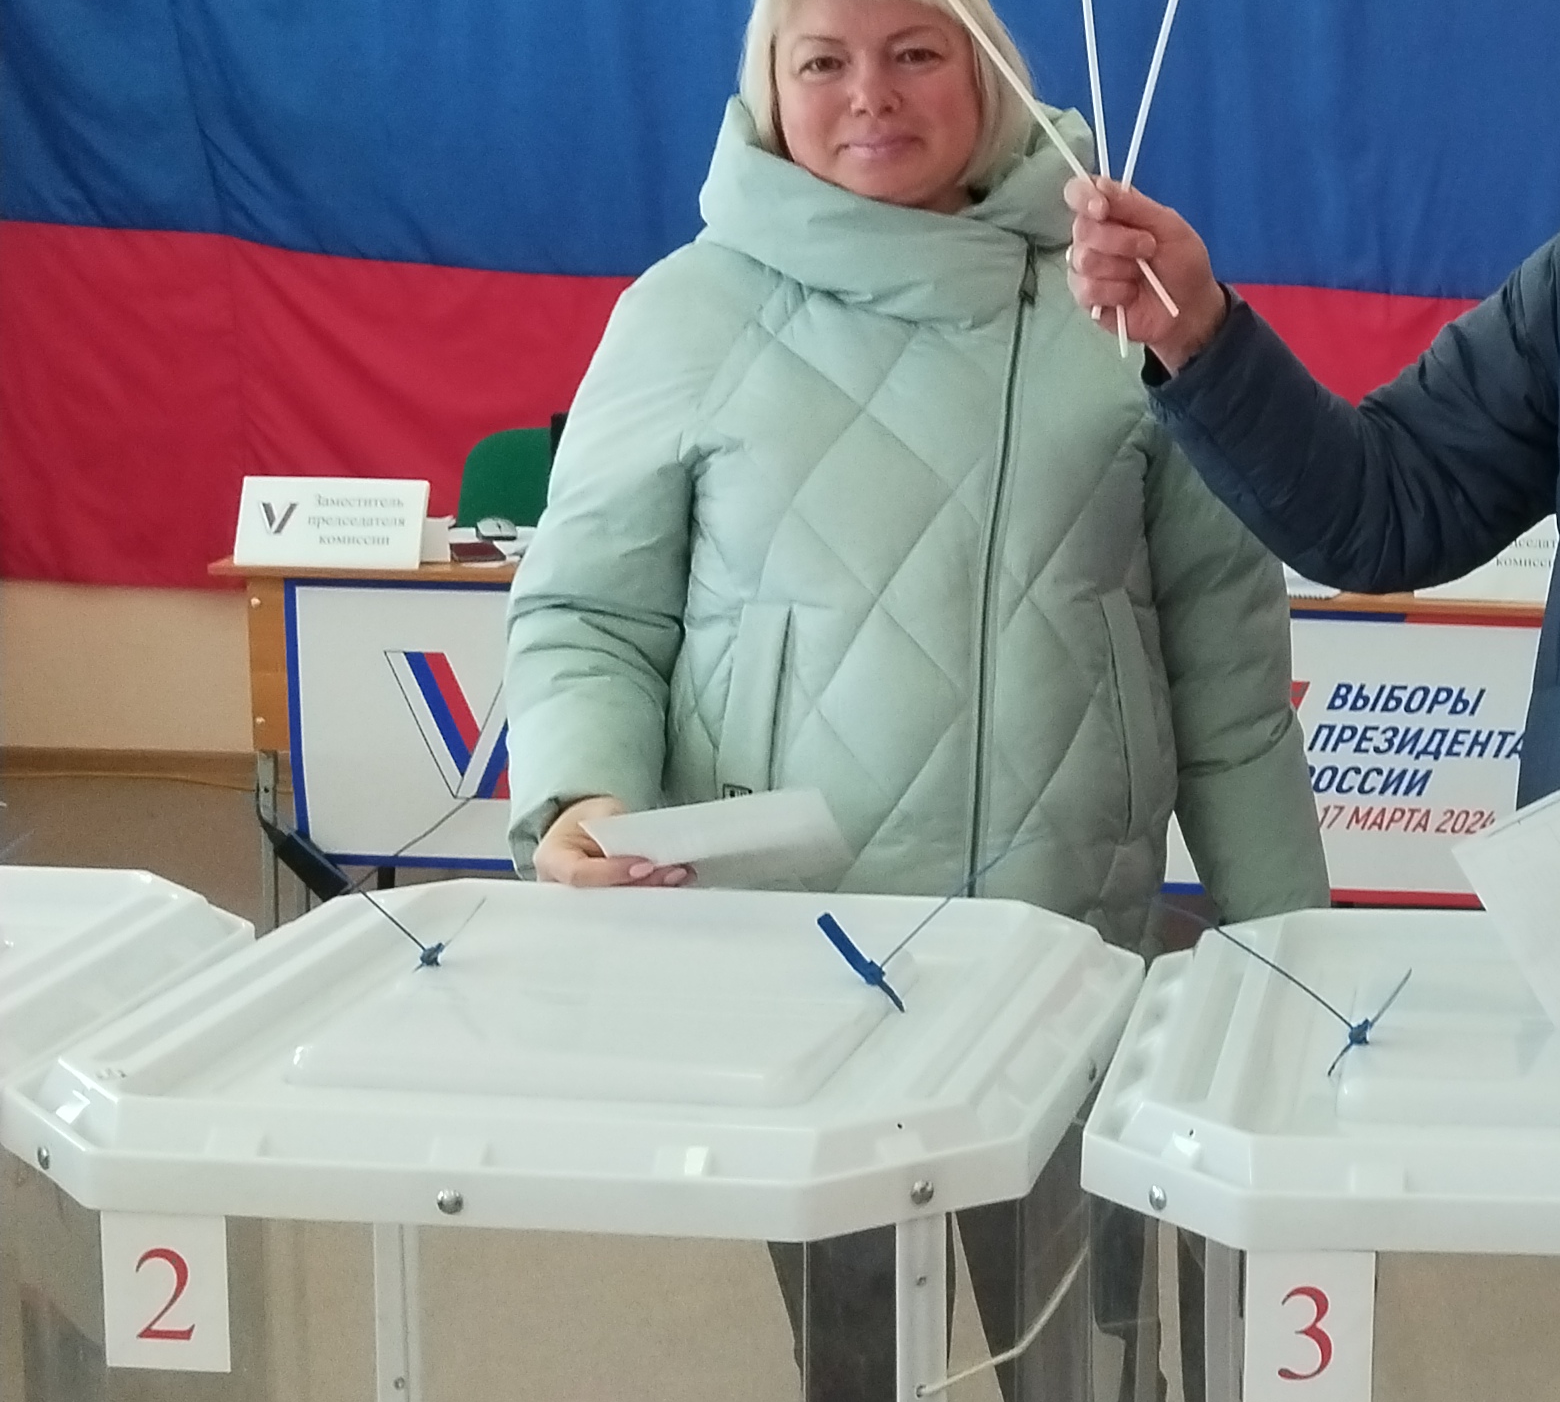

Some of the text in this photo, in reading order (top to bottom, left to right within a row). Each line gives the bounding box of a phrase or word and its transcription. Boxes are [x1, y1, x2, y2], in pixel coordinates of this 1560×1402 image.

[315, 494, 404, 509] Заместитель
[308, 514, 405, 528] председателя
[319, 535, 390, 546] комиссии
[1327, 683, 1486, 716] ВЫБОРЫ
[1307, 724, 1523, 760] ПРЕЗИДЕНТА
[1346, 805, 1432, 833] МАРТА
[135, 1247, 196, 1341] 2
[1278, 1286, 1333, 1380] 3
